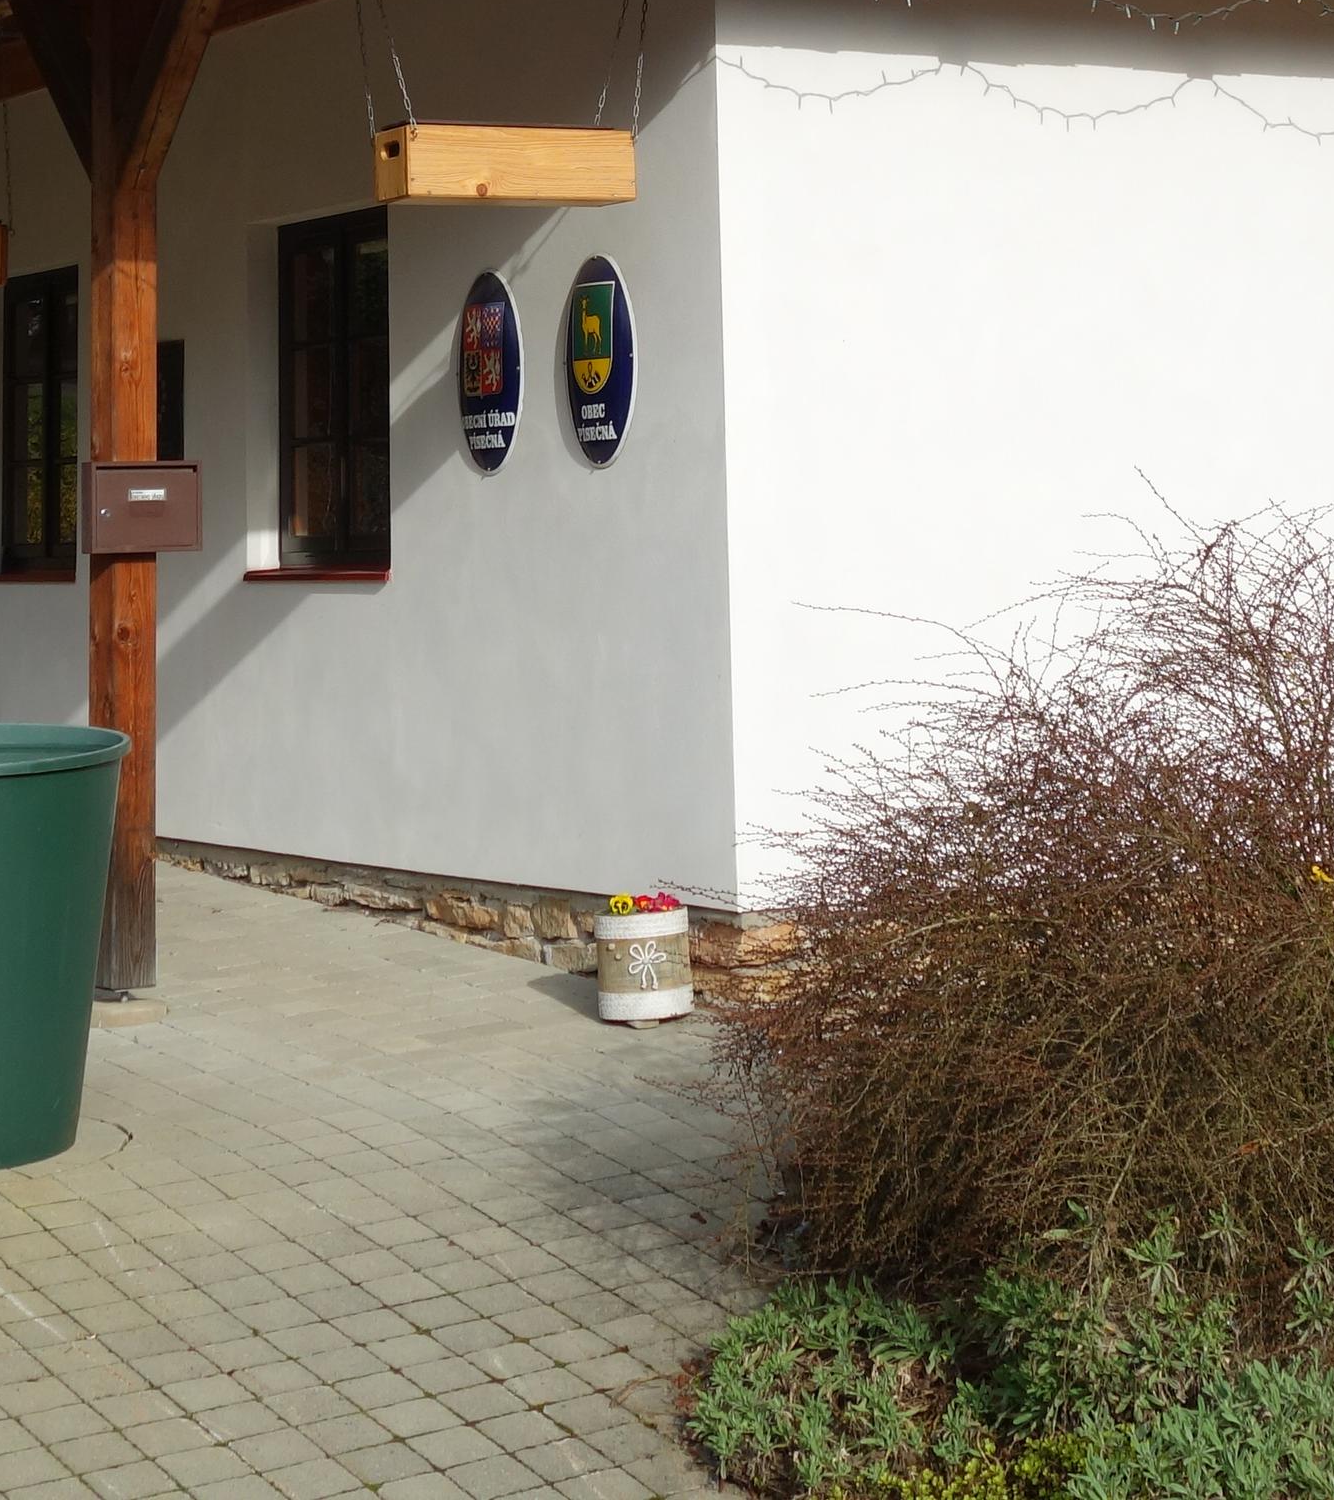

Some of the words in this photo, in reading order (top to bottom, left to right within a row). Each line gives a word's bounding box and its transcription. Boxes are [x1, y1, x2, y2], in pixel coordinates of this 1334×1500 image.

[487, 408, 515, 427] ÚŘAD
[581, 403, 605, 420] OBEC
[468, 430, 506, 450] PÍSEČNÁ
[578, 421, 617, 443] PÍSEČNÁ
